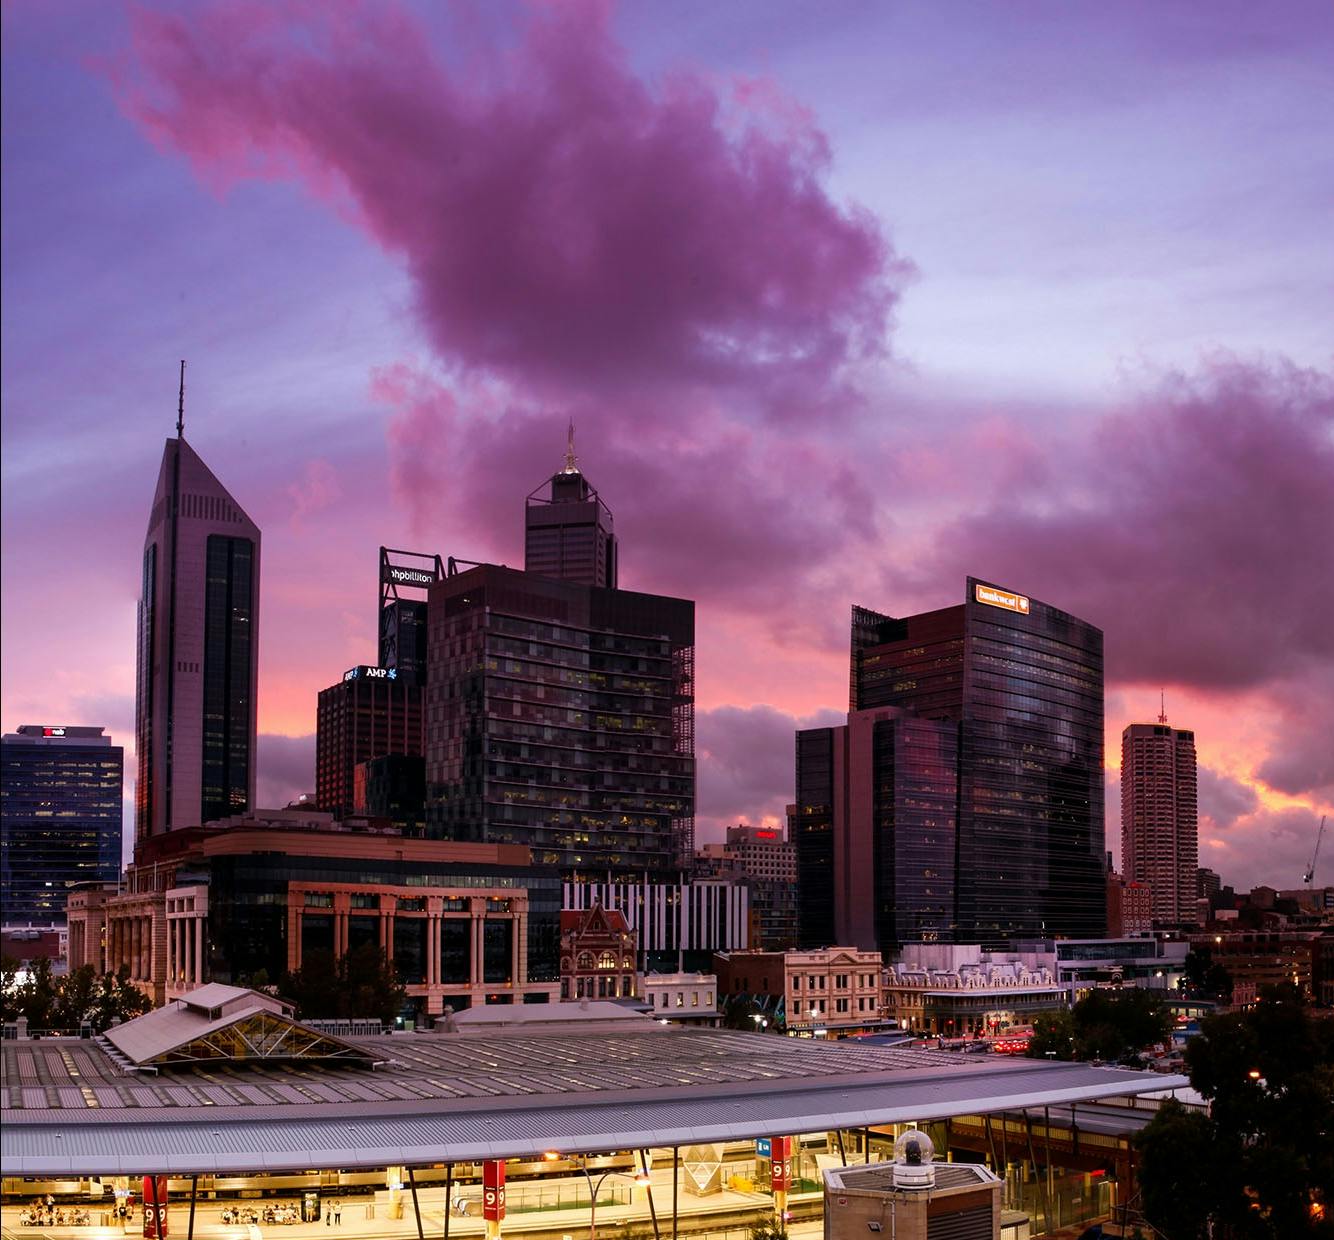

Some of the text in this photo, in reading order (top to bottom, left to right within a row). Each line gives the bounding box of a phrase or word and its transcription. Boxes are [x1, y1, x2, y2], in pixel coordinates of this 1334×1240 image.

[979, 588, 1016, 607] bankwest
[366, 668, 387, 678] AMP
[774, 1165, 782, 1177] 9
[785, 1164, 790, 1177] 9
[486, 1192, 495, 1205] 9
[499, 1191, 504, 1205] 9
[145, 1208, 154, 1222] 9
[159, 1208, 166, 1221] 9
